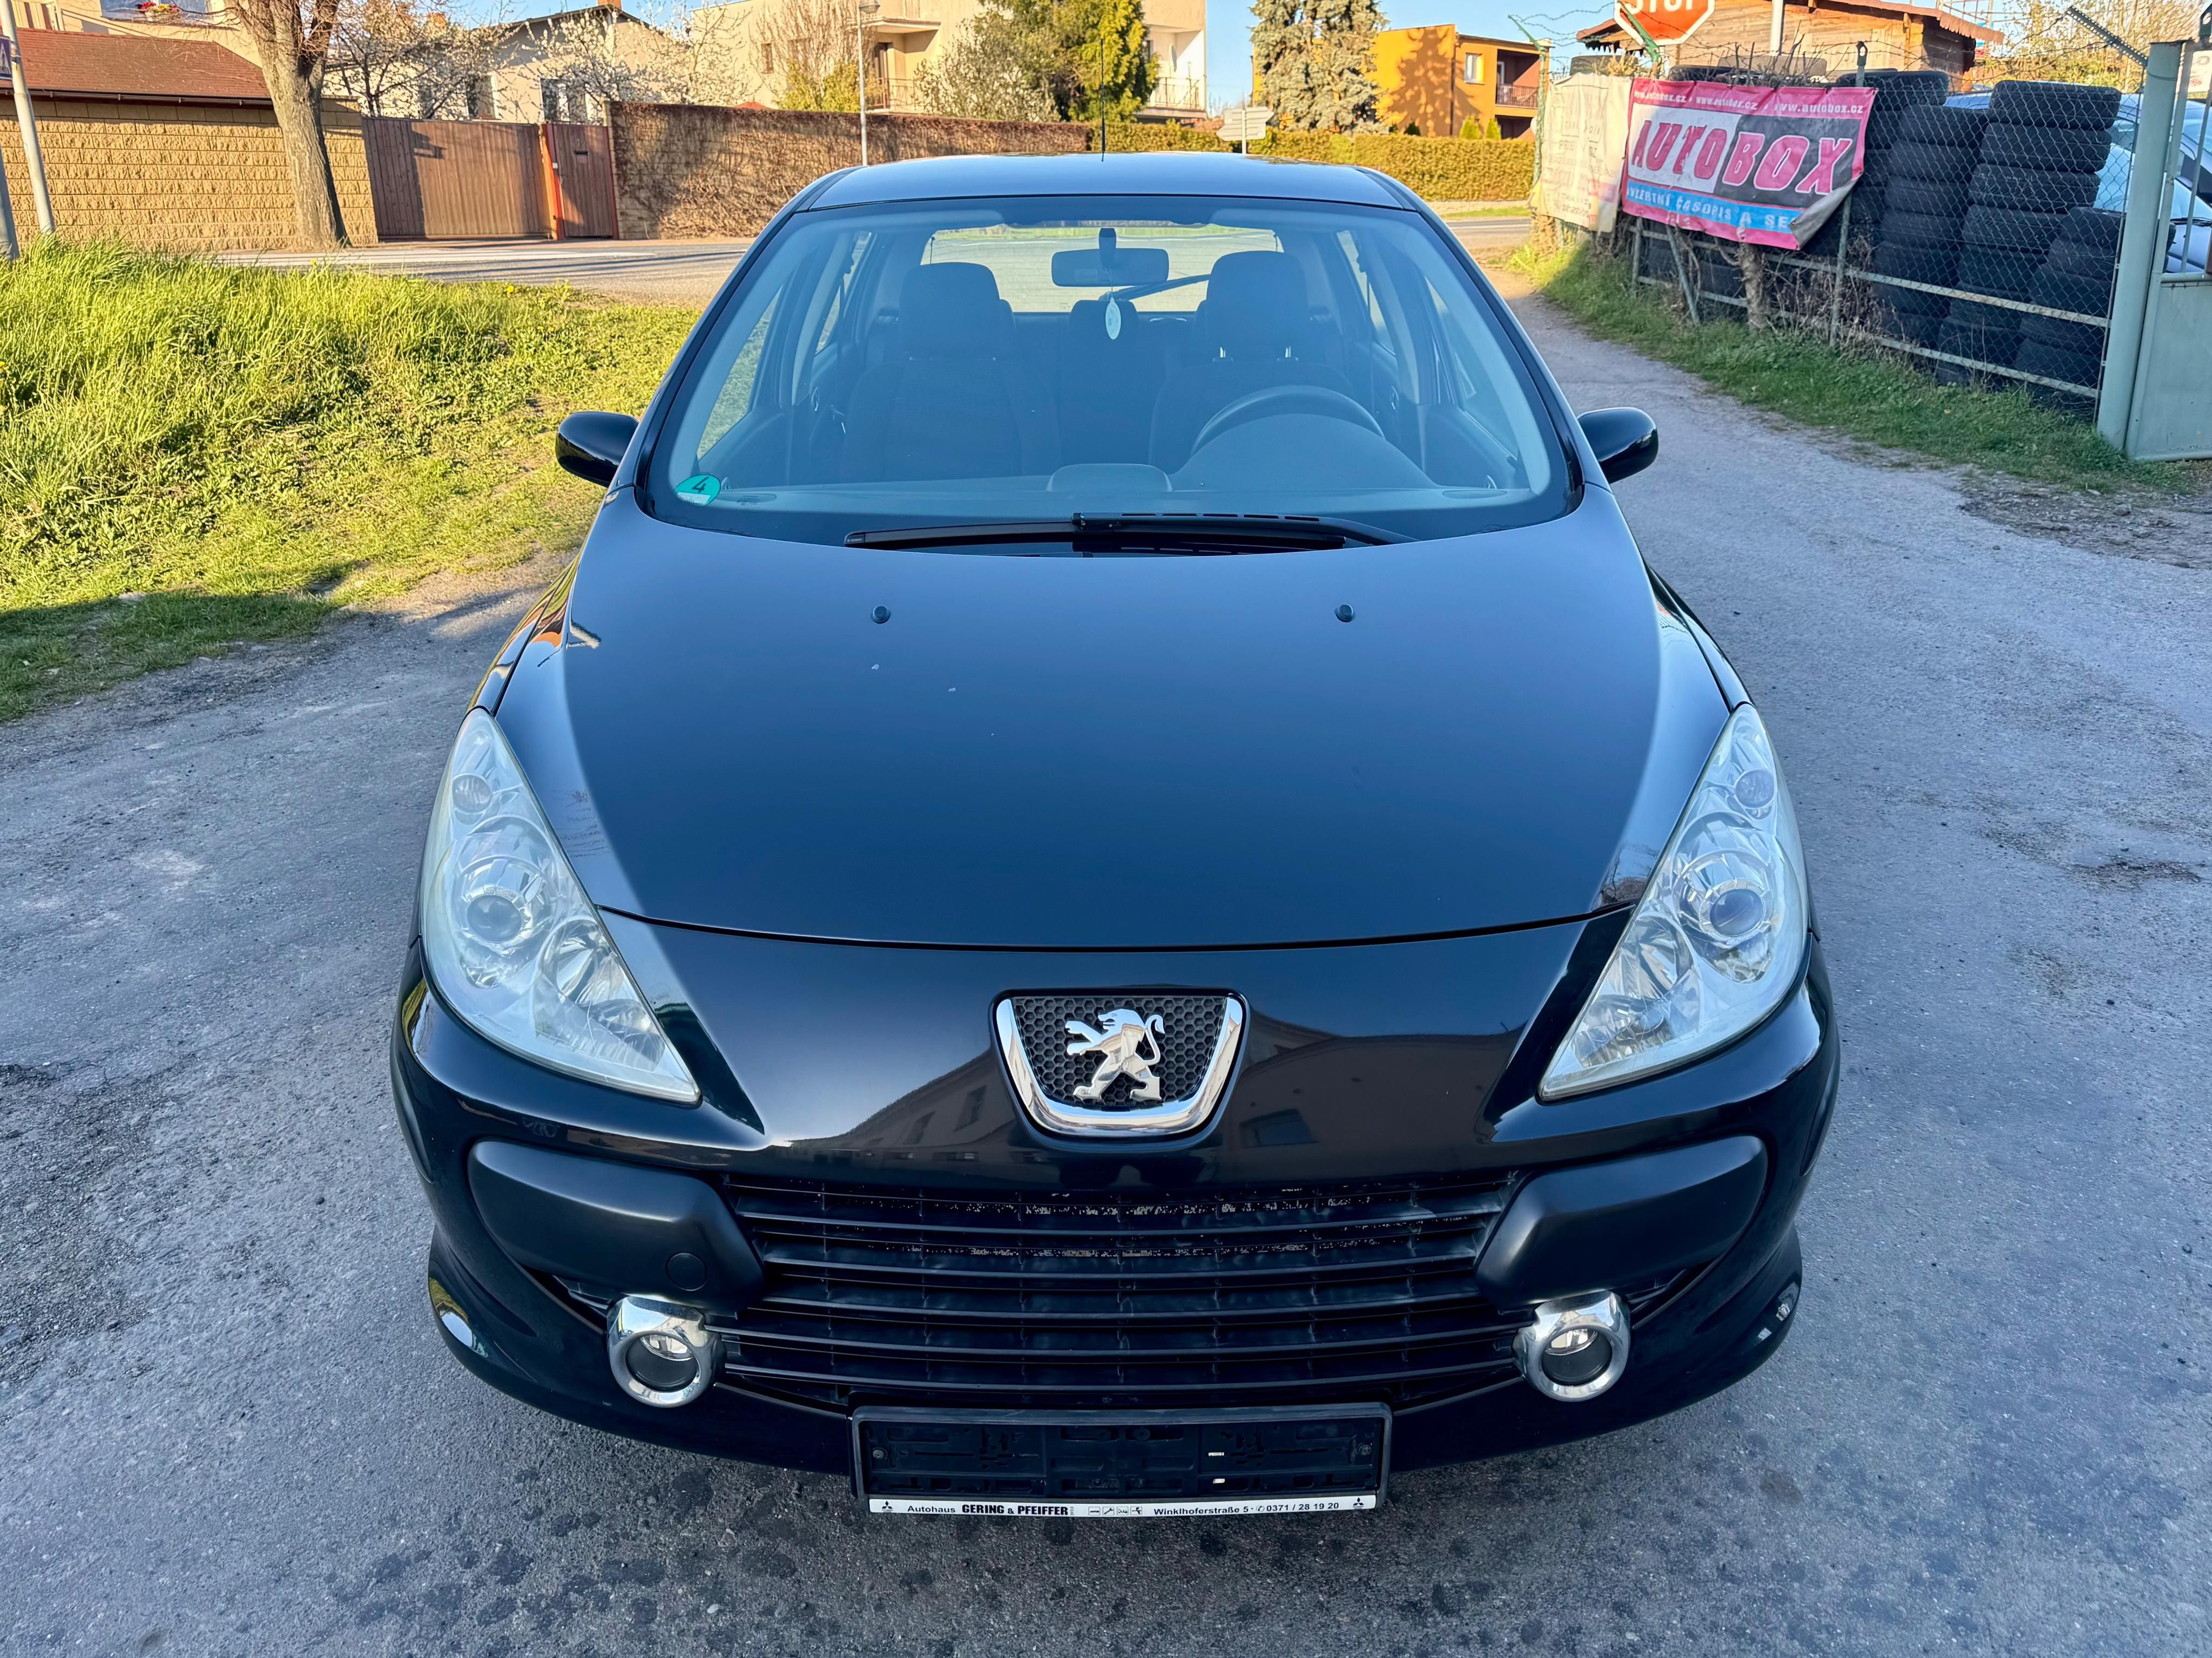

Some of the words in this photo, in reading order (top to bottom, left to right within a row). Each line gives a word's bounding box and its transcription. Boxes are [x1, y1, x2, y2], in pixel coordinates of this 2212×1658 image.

[1631, 120, 1853, 195] AUTOBOX
[1676, 196, 1731, 220] ČASOPIS
[1739, 212, 1752, 225] A
[691, 476, 710, 493] 4
[962, 1504, 1004, 1514] GERING
[1017, 1505, 1068, 1515] PFEIFFER
[1154, 1507, 1239, 1515] Winklhoferstraße
